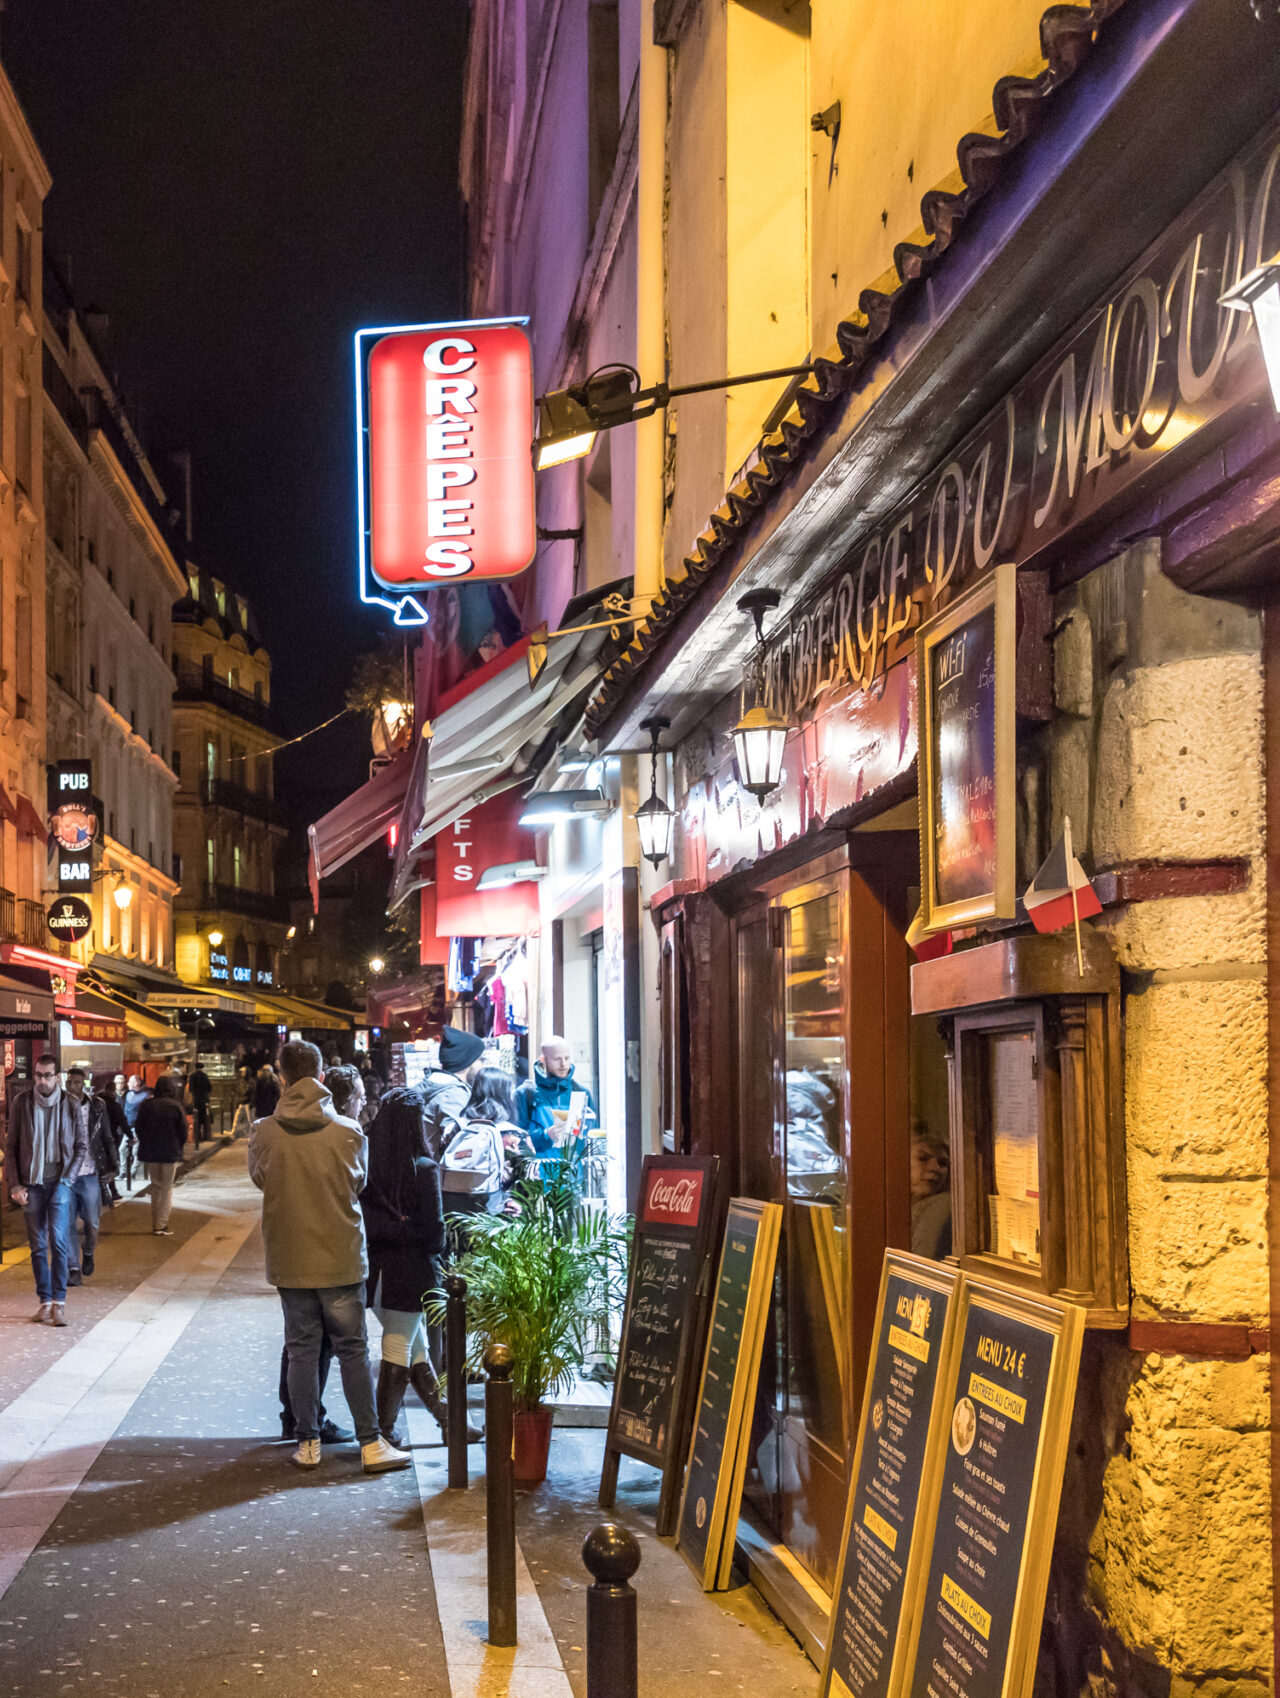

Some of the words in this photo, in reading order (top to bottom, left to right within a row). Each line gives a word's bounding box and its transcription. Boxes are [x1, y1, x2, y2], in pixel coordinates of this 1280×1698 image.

[423, 338, 476, 577] CRÊPES
[925, 397, 1016, 601] DU
[59, 773, 89, 791] PUB
[56, 835, 93, 850] BROTHERS
[453, 818, 474, 882] FTS
[60, 863, 90, 880] BAR
[49, 917, 88, 928] GUINNESS
[5, 1043, 13, 1069] BAR
[649, 1177, 698, 1214] Coca-Cola
[976, 1334, 1003, 1367] MENU
[1003, 1345, 1017, 1374] 24
[1018, 1352, 1026, 1378] €
[971, 1379, 994, 1402] ENTREES
[994, 1390, 1004, 1407] AU
[1003, 1395, 1022, 1417] CHOIX
[978, 1407, 994, 1425] Saumon
[963, 1458, 972, 1472] Foie
[972, 1463, 981, 1478] gras
[951, 1482, 964, 1500] Salade
[996, 1514, 1010, 1533] chaud
[956, 1546, 968, 1565] Soupe
[974, 1560, 986, 1579] choix
[944, 1582, 960, 1607] PLATS
[959, 1595, 968, 1615] AU
[968, 1603, 987, 1631] CHOIX
[973, 1636, 988, 1659] sauces
